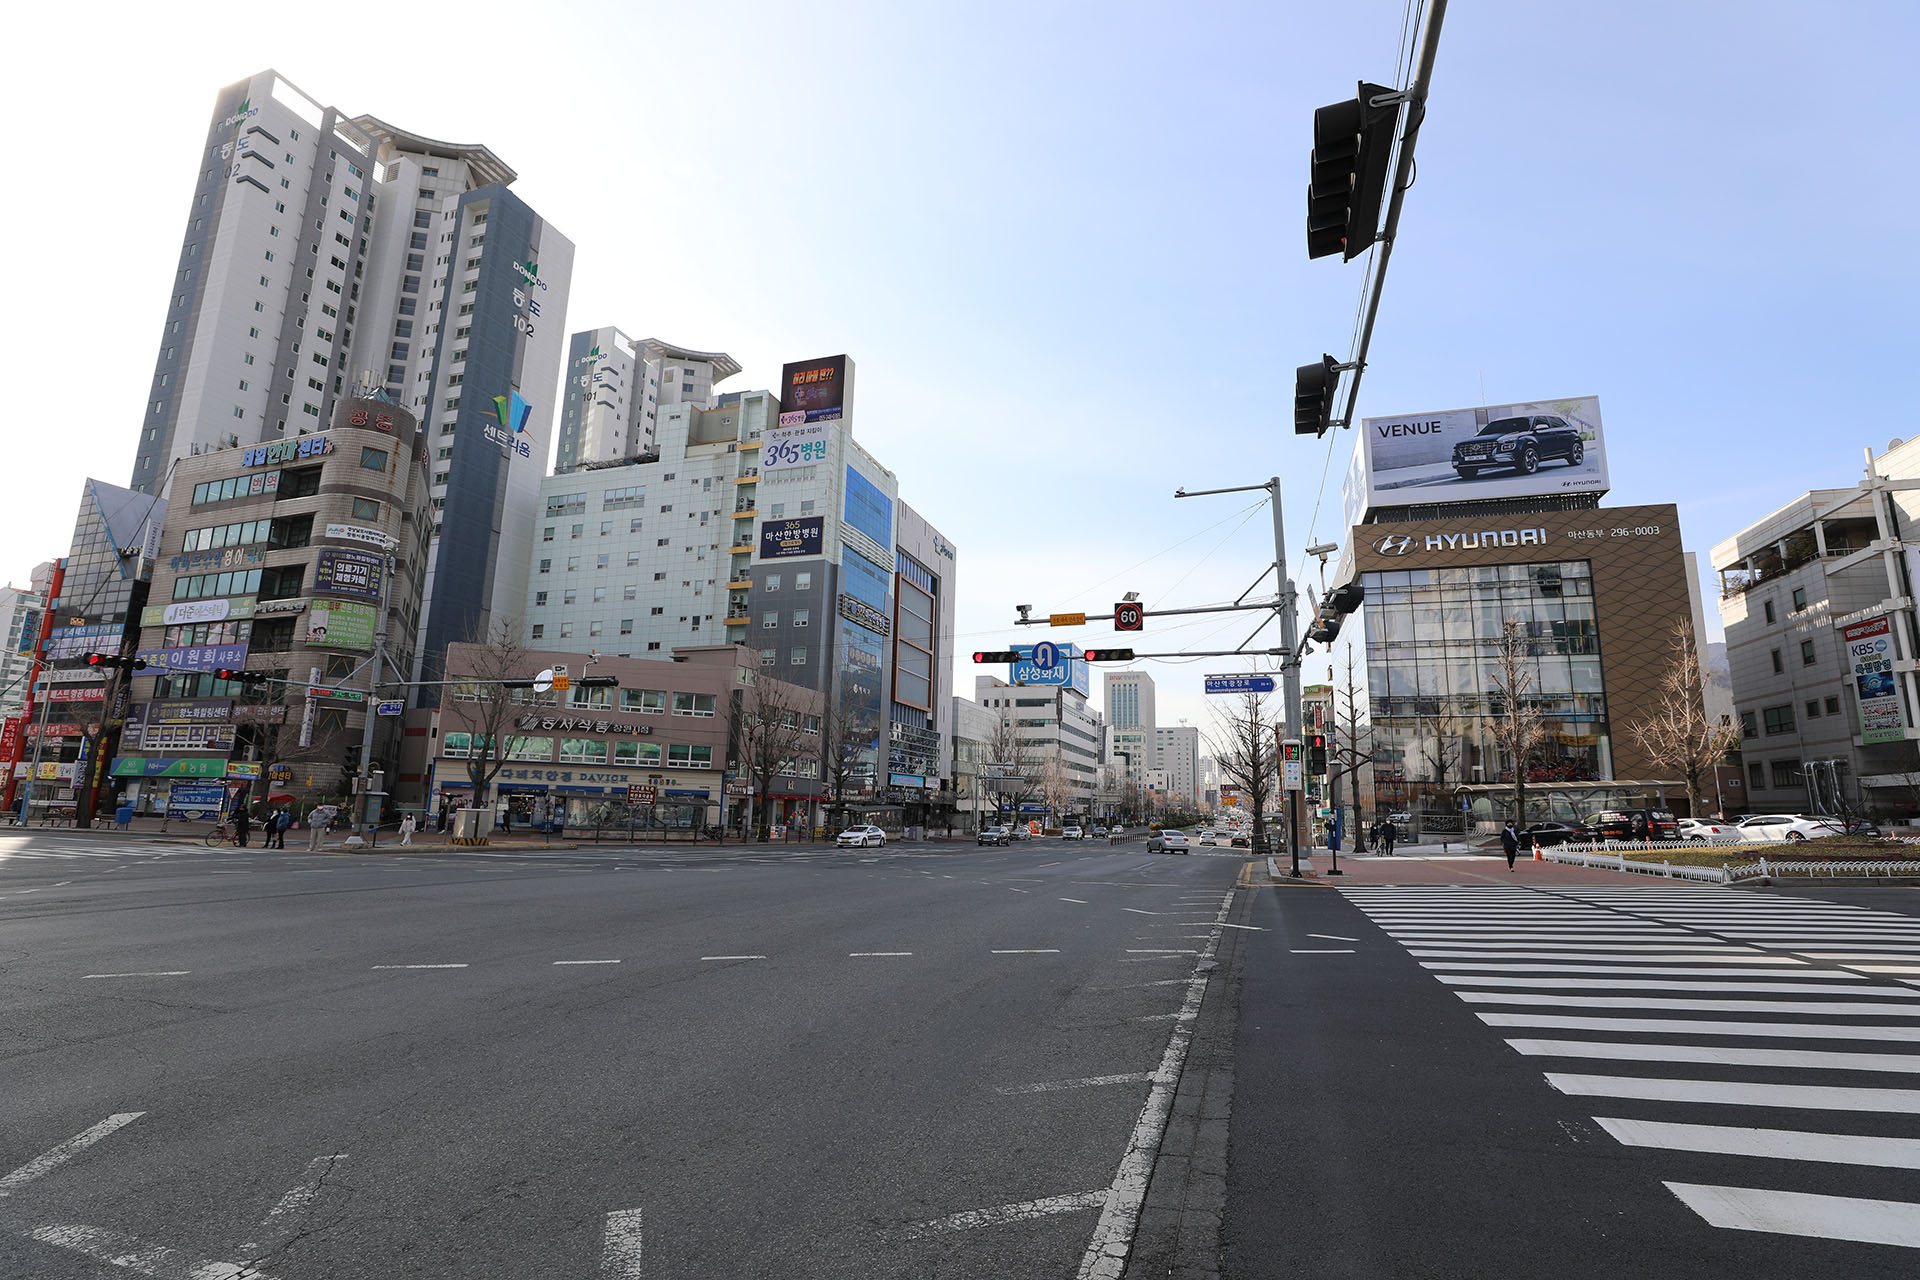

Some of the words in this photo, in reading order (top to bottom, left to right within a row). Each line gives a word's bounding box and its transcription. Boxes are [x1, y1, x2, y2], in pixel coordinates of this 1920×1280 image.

[513, 260, 548, 292] DONGDO
[512, 313, 535, 339] 102
[583, 391, 597, 402] 101
[1378, 420, 1442, 438] VENUE
[252, 473, 278, 492] 번역
[785, 520, 800, 529] 365
[765, 527, 819, 542] 마산한방병원
[1425, 528, 1546, 551] HYUNDAI
[1567, 529, 1605, 540] 마산동부
[1610, 526, 1660, 538] 296-0003
[224, 547, 245, 567] 영어
[336, 562, 368, 576] 의료기기
[1121, 611, 1137, 623] 60
[171, 648, 217, 666] 이원희
[217, 653, 242, 663] 사무소
[1851, 642, 1875, 657] KBS
[1018, 665, 1065, 680] 삼성화재
[541, 714, 613, 735] 동서식품
[501, 768, 573, 783] 다비치안경
[580, 773, 629, 782] DAVICH
